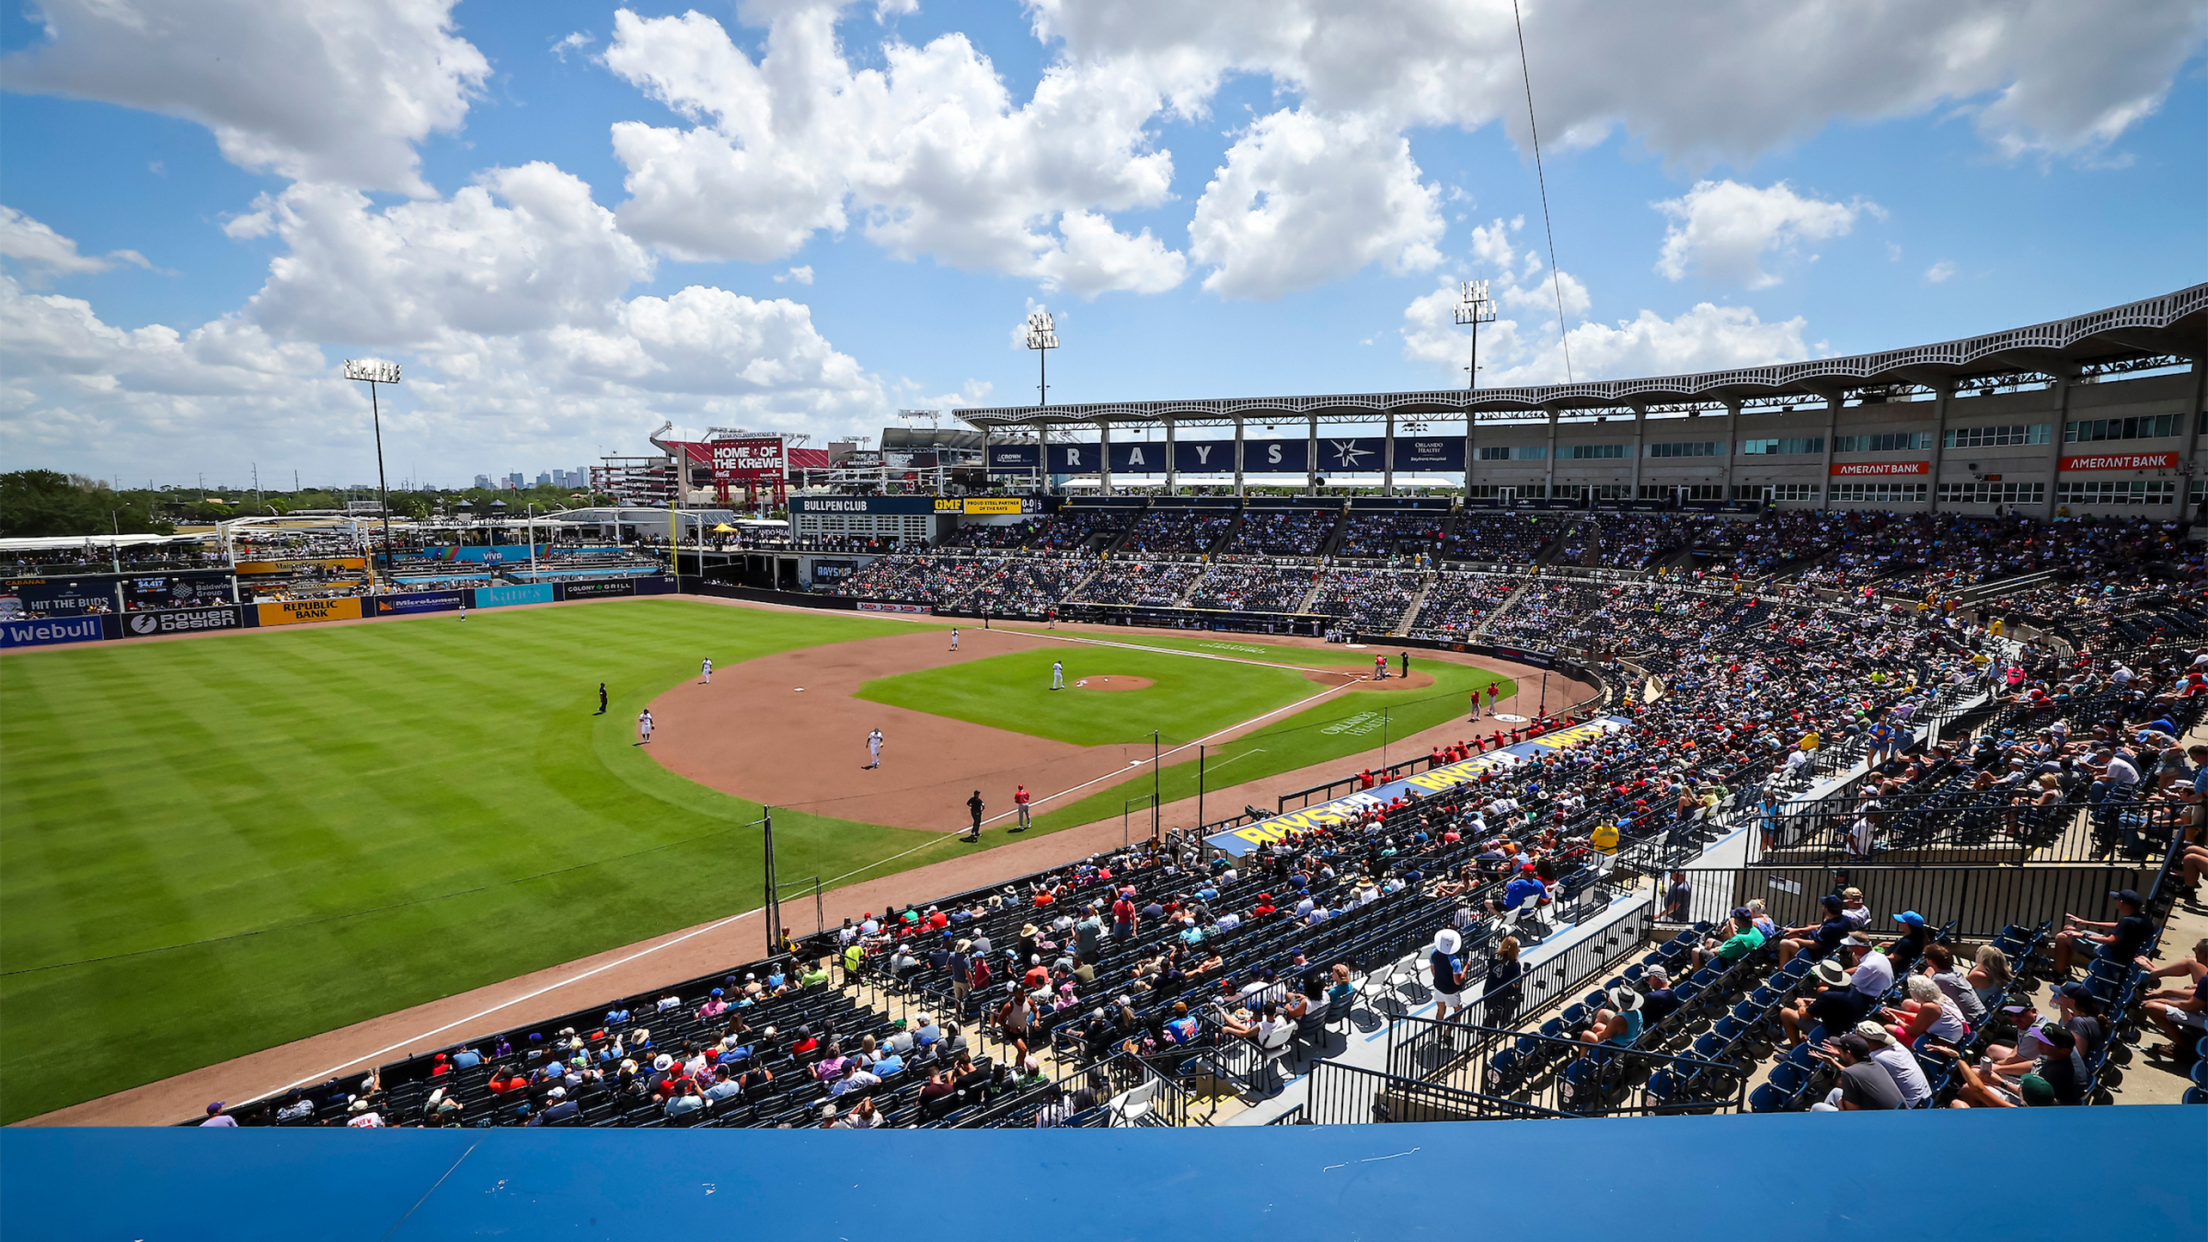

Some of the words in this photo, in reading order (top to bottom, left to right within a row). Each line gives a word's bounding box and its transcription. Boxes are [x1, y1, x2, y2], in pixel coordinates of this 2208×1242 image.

[714, 447, 750, 458] HOME
[760, 446, 777, 457] OF
[712, 459, 736, 469] THE
[738, 458, 782, 468] KREWE
[2070, 457, 2131, 469] AMERANT
[2132, 455, 2167, 467] BANK
[1840, 464, 1889, 474] AMERANT
[1891, 464, 1918, 474] BANK
[804, 501, 843, 511] BULLPEN
[844, 501, 867, 511] CLUB
[934, 499, 962, 510] GMF
[818, 566, 838, 576] RAYS
[31, 601, 51, 610] HIT
[53, 599, 76, 608] THE
[284, 601, 338, 612] REPUBLIC
[296, 609, 328, 619] BANK
[10, 621, 96, 642] Webull
[1321, 712, 1377, 734] ORLANDO
[1406, 761, 1484, 791] RAYS
[1232, 808, 1343, 846] RAYS
